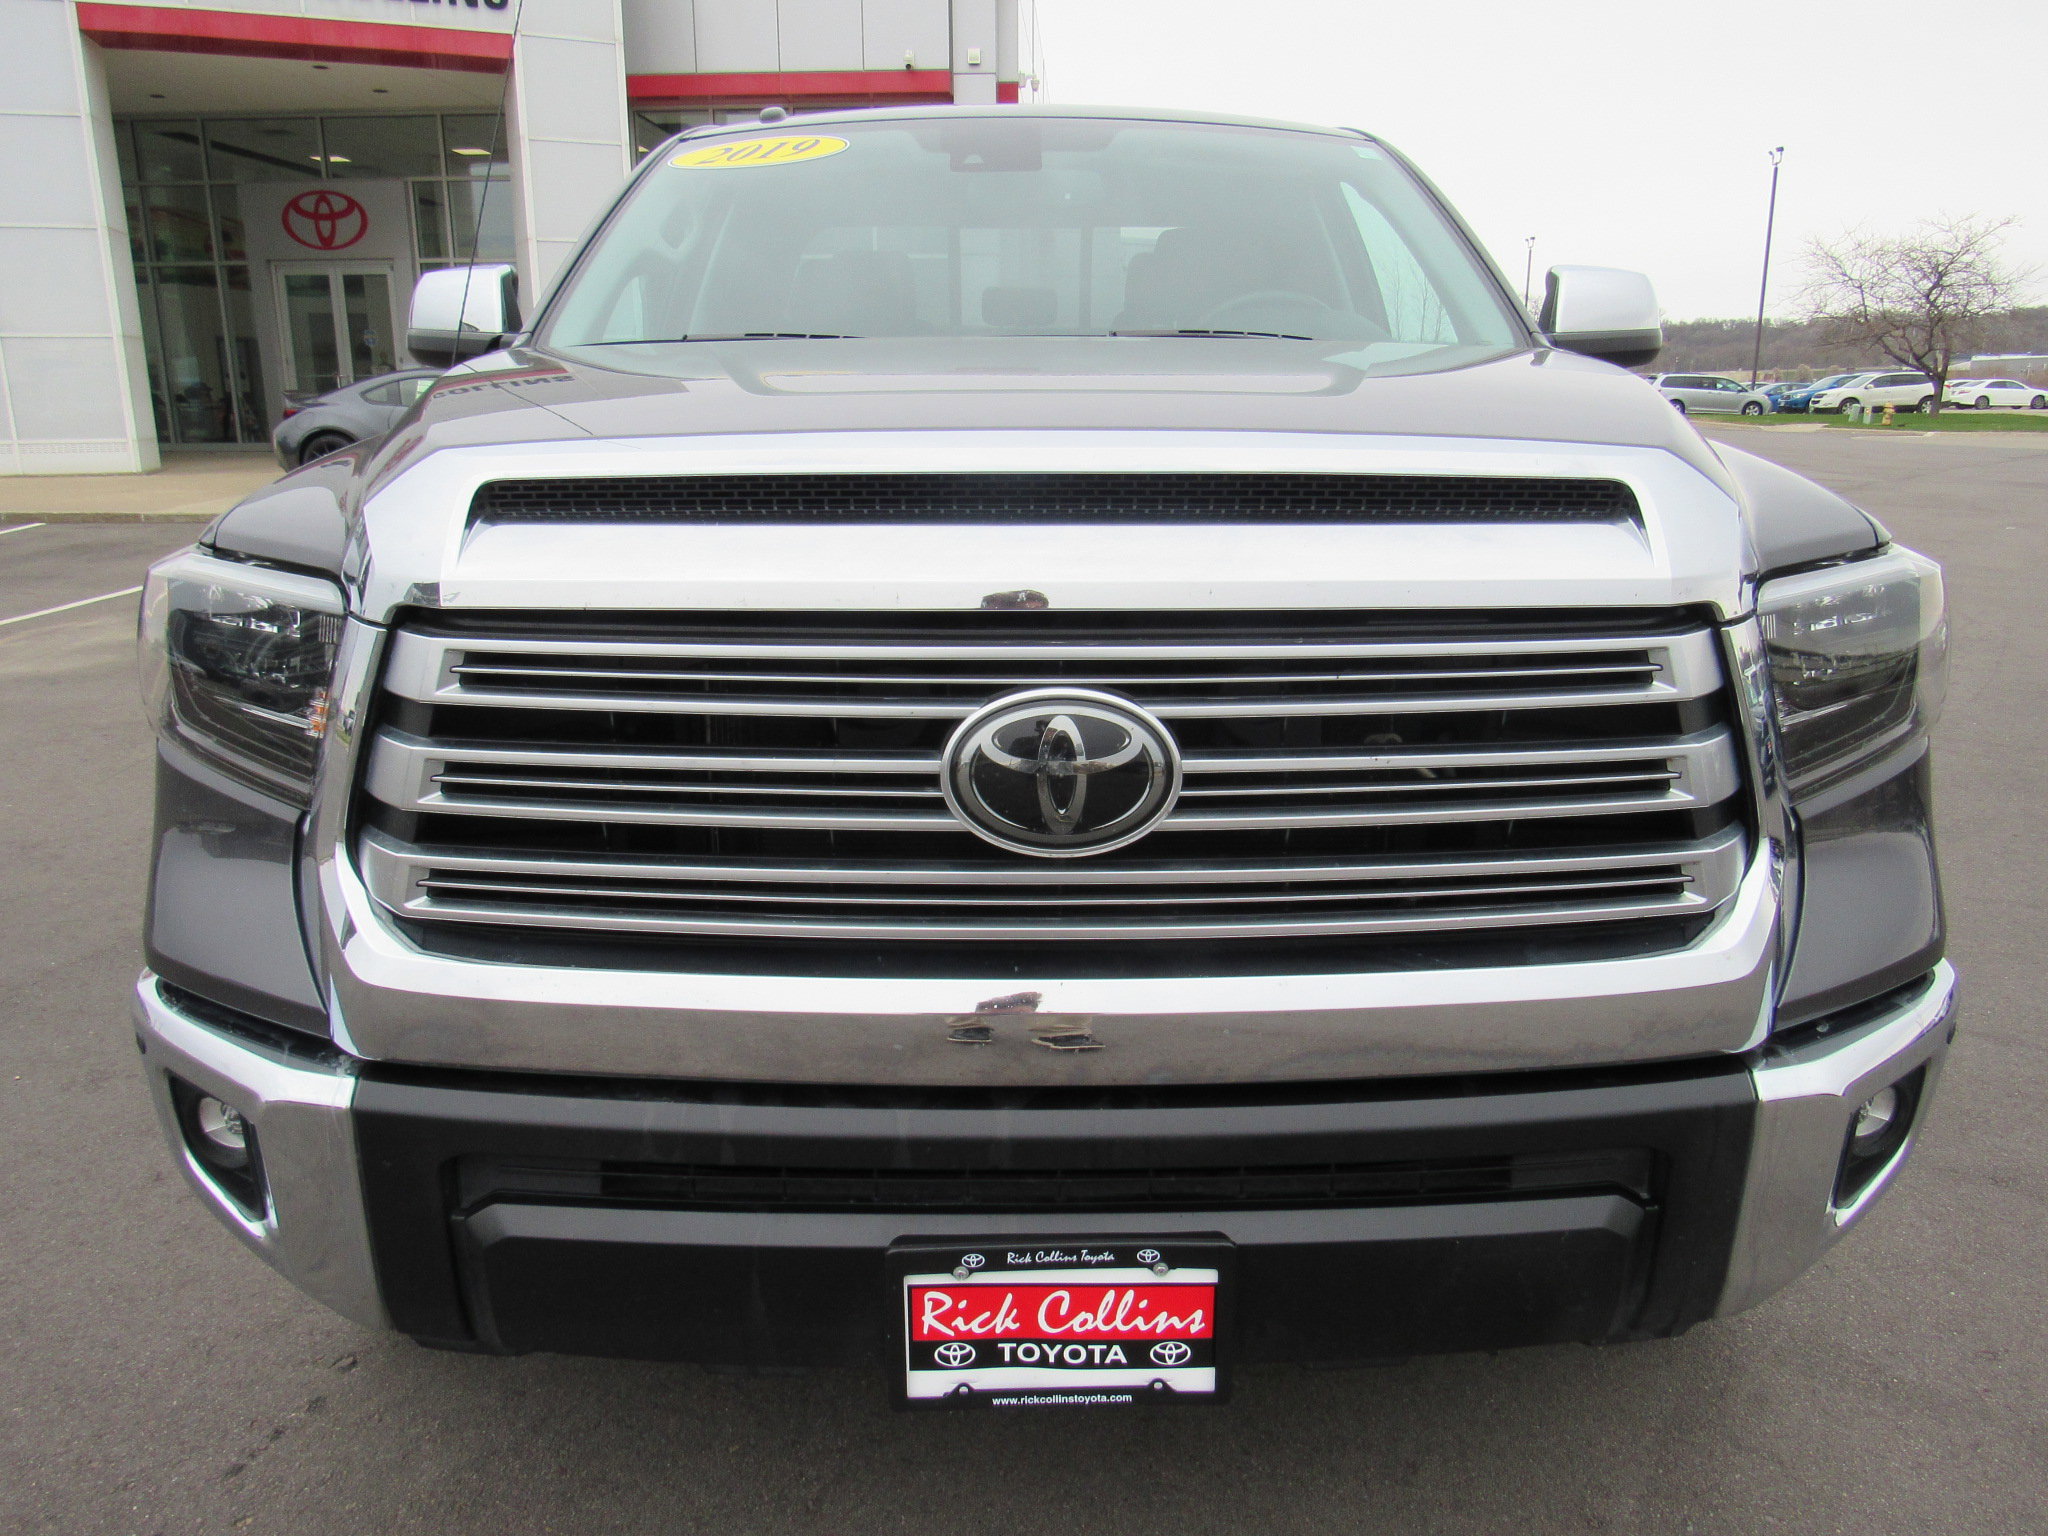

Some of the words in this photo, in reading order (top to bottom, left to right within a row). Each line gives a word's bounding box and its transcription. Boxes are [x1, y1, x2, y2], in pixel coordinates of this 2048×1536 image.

[695, 139, 821, 166] 2019
[1007, 1251, 1032, 1264] Rick
[1035, 1250, 1077, 1263] Collins
[1080, 1249, 1115, 1264] Toyota
[921, 1290, 1020, 1336] Rick
[1037, 1289, 1206, 1334] Collins
[997, 1342, 1128, 1364] TOYOTA
[992, 1393, 1133, 1406] www.rickcollinstoyota.com
